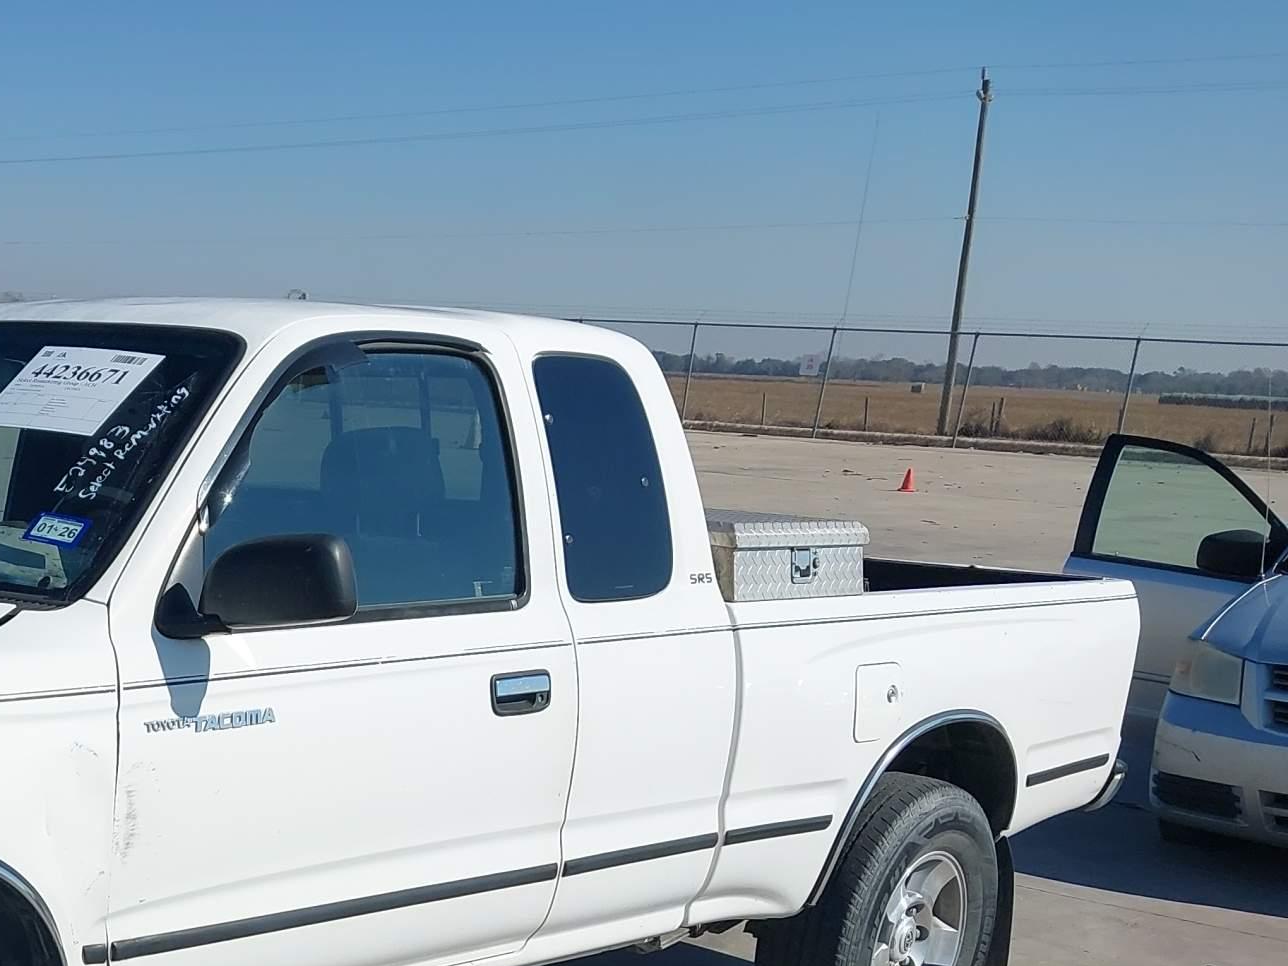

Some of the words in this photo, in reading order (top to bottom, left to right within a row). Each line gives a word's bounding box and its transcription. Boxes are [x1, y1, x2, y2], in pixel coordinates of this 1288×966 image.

[31, 363, 129, 385] 44236671
[78, 461, 115, 500] Select
[36, 522, 55, 535] 01
[57, 526, 78, 539] 26
[143, 716, 191, 733] TOYOTA
[191, 707, 277, 733] TACOMA
